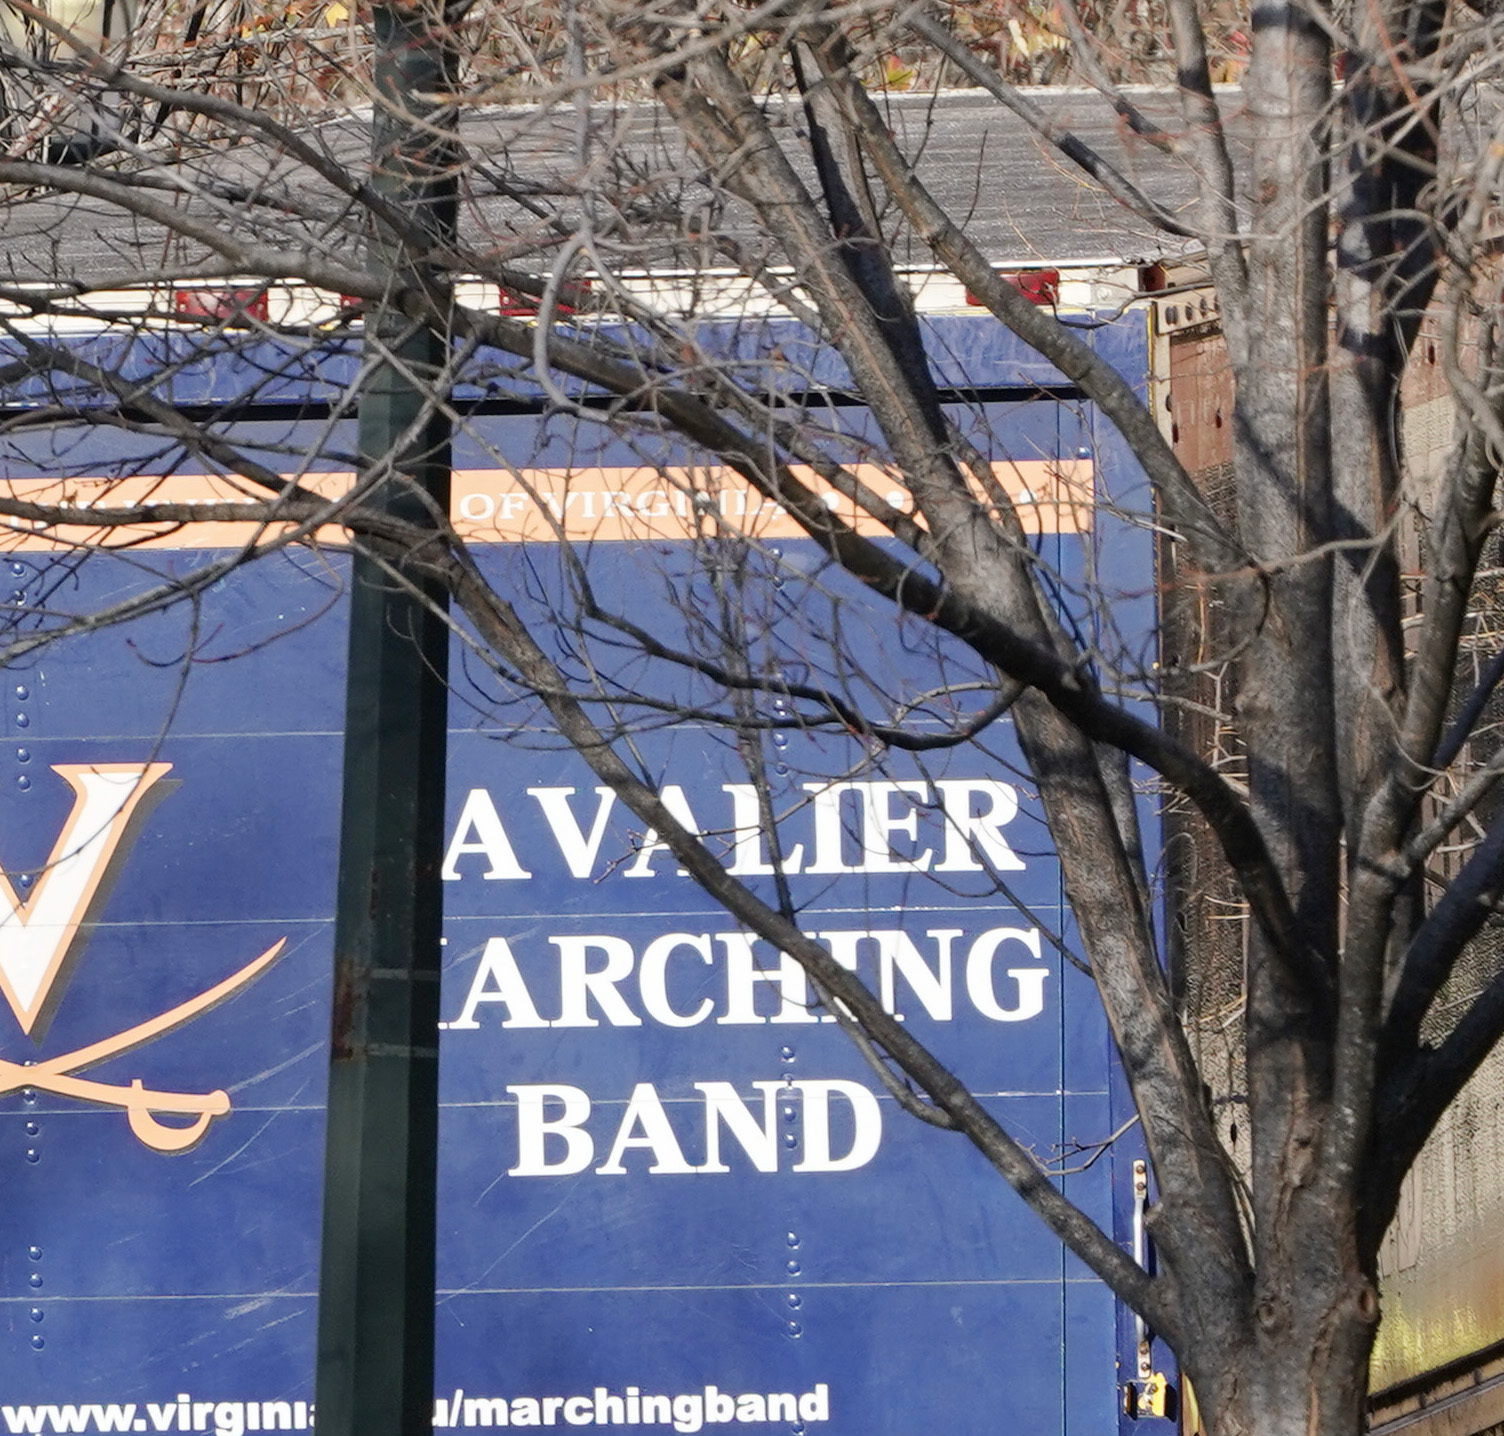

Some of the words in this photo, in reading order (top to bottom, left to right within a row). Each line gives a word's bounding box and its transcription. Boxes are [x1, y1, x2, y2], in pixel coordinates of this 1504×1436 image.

[458, 492, 529, 521] OF
[442, 780, 1027, 882] AVALIER
[439, 926, 1050, 1030] ARCHING
[506, 1079, 883, 1177] BAND
